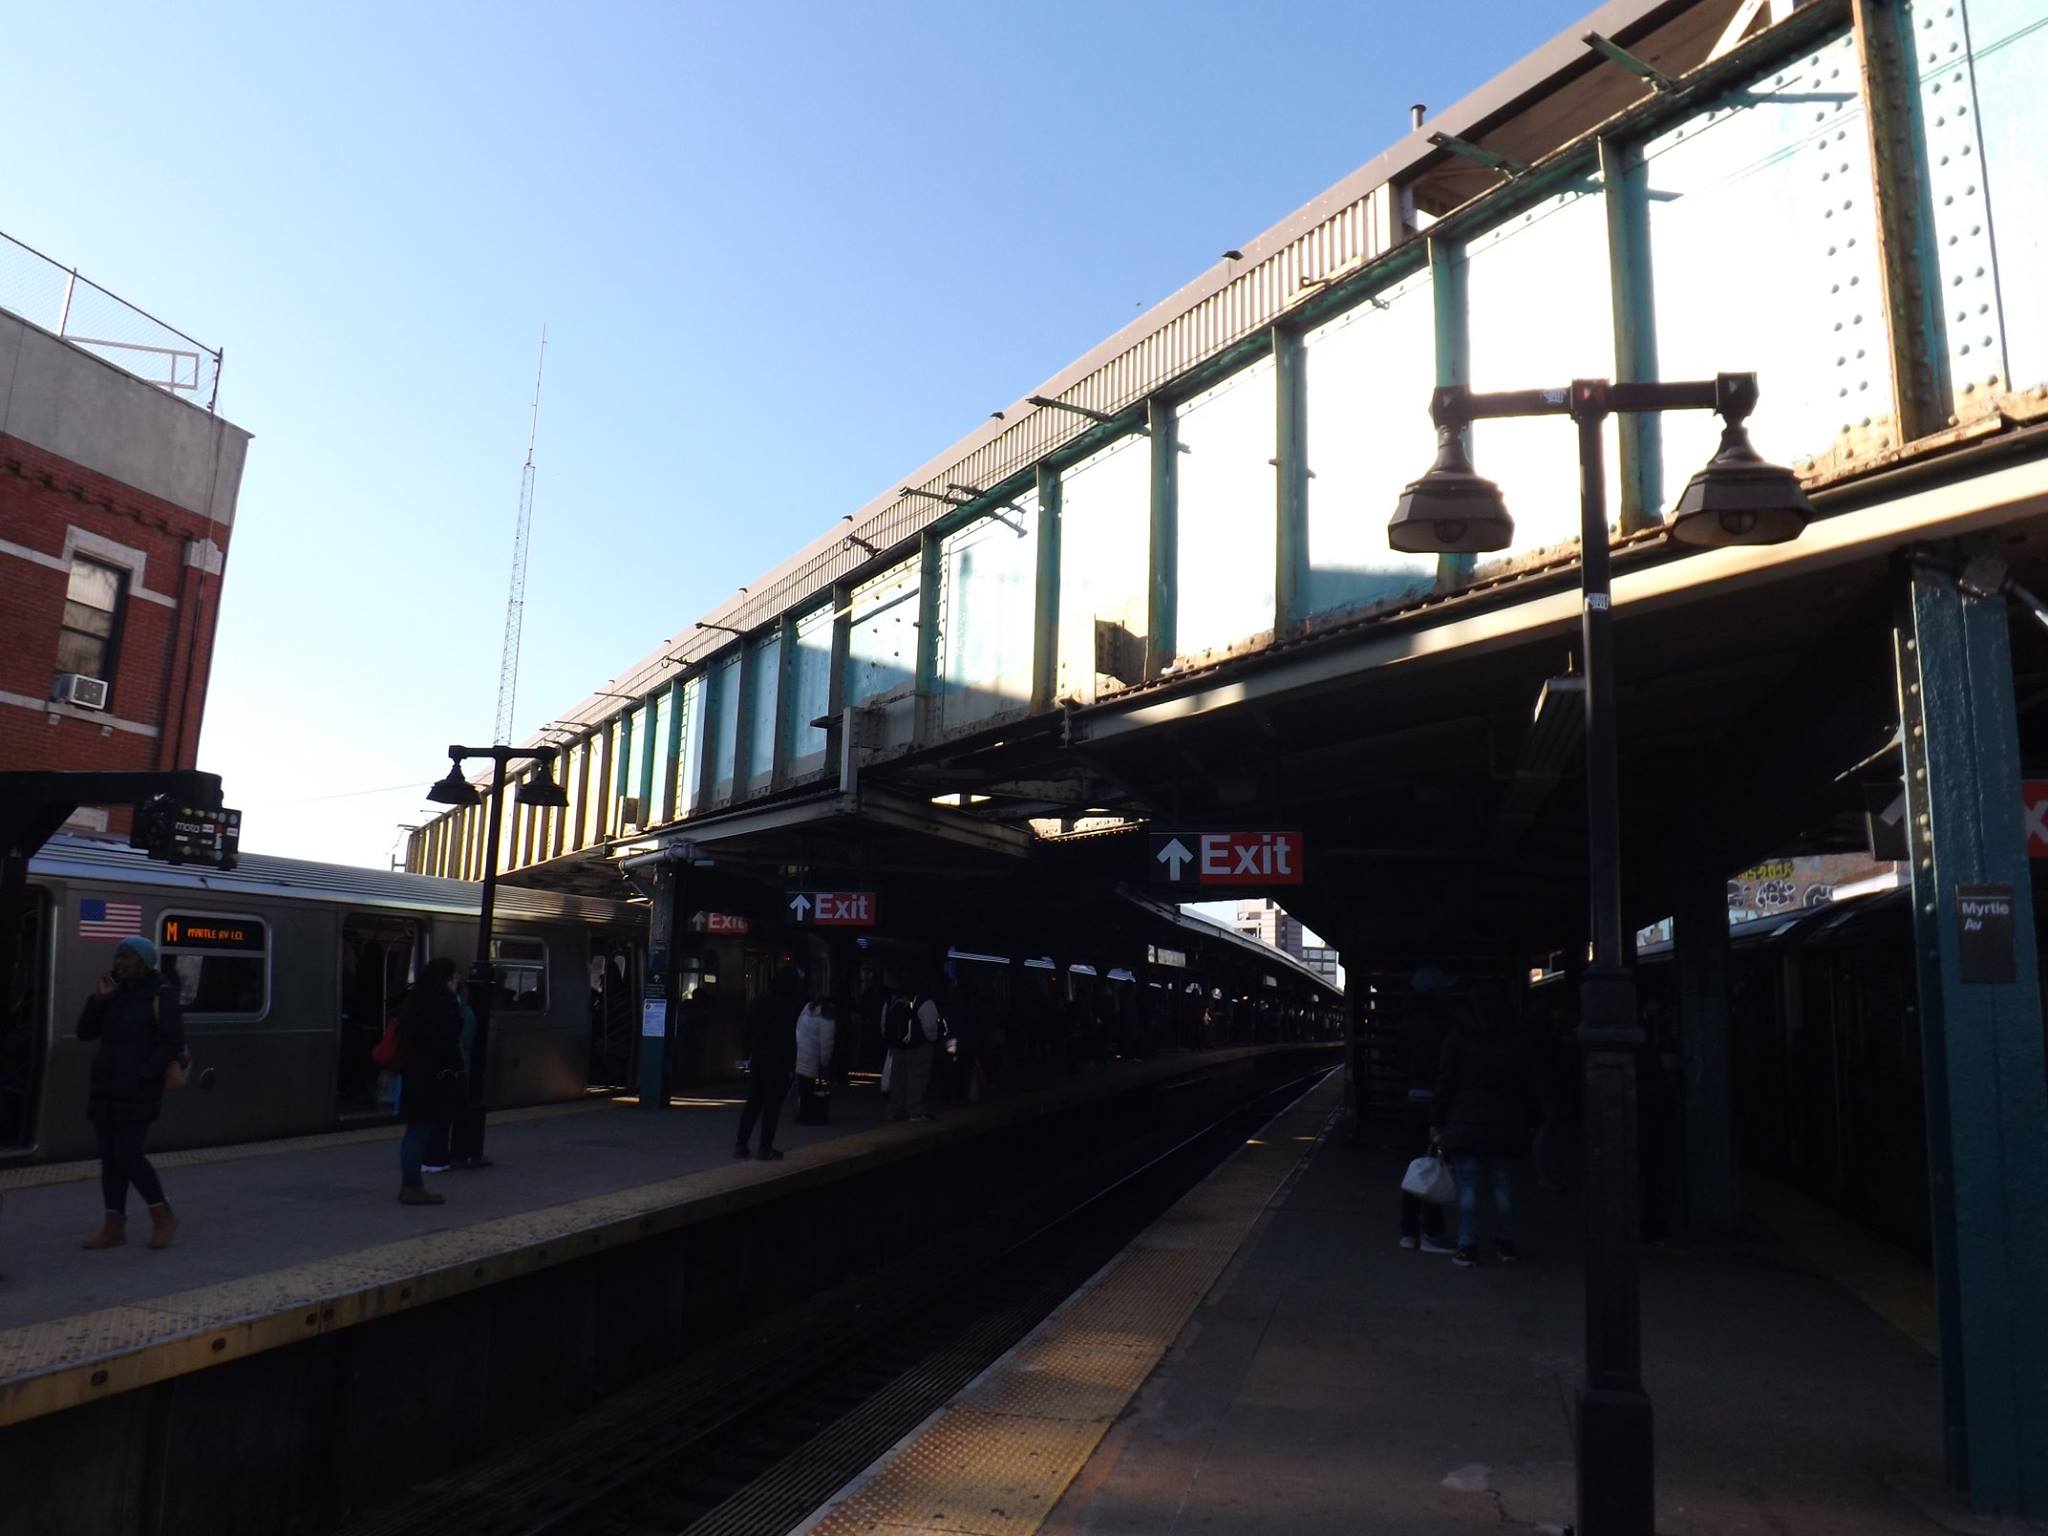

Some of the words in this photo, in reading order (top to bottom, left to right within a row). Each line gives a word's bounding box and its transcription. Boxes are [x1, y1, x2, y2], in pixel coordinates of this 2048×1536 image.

[1201, 834, 1292, 875] Exit
[815, 893, 868, 920] Exit
[1961, 901, 2010, 917] Myrtle
[166, 921, 179, 942] M
[187, 927, 217, 939] MYRTLE
[218, 930, 230, 940] AV
[1964, 917, 1983, 932] Av
